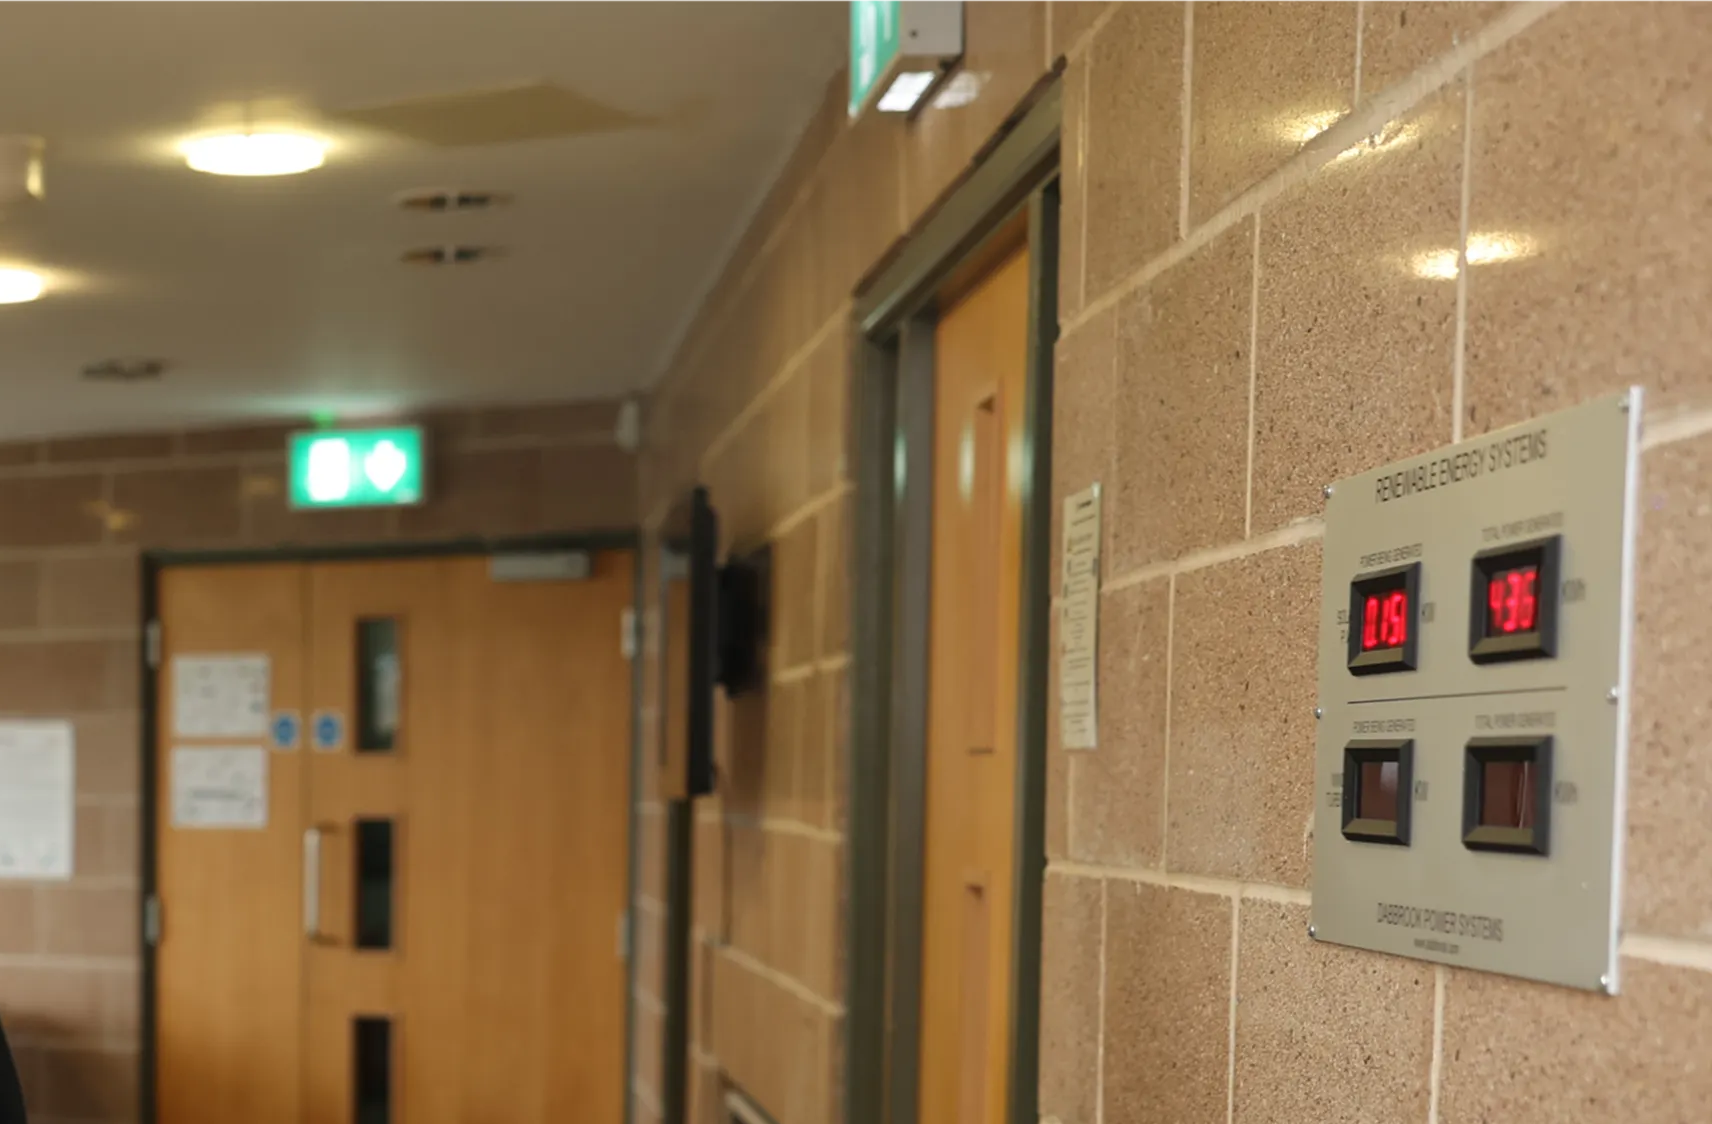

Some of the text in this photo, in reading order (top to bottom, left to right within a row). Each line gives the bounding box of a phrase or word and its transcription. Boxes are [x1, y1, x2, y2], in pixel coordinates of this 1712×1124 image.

[1375, 429, 1548, 504] RENEWABLE ENERGY SYSTEMS
[1422, 907, 1457, 935] POWER
[1458, 911, 1504, 943] SYSTEMS
